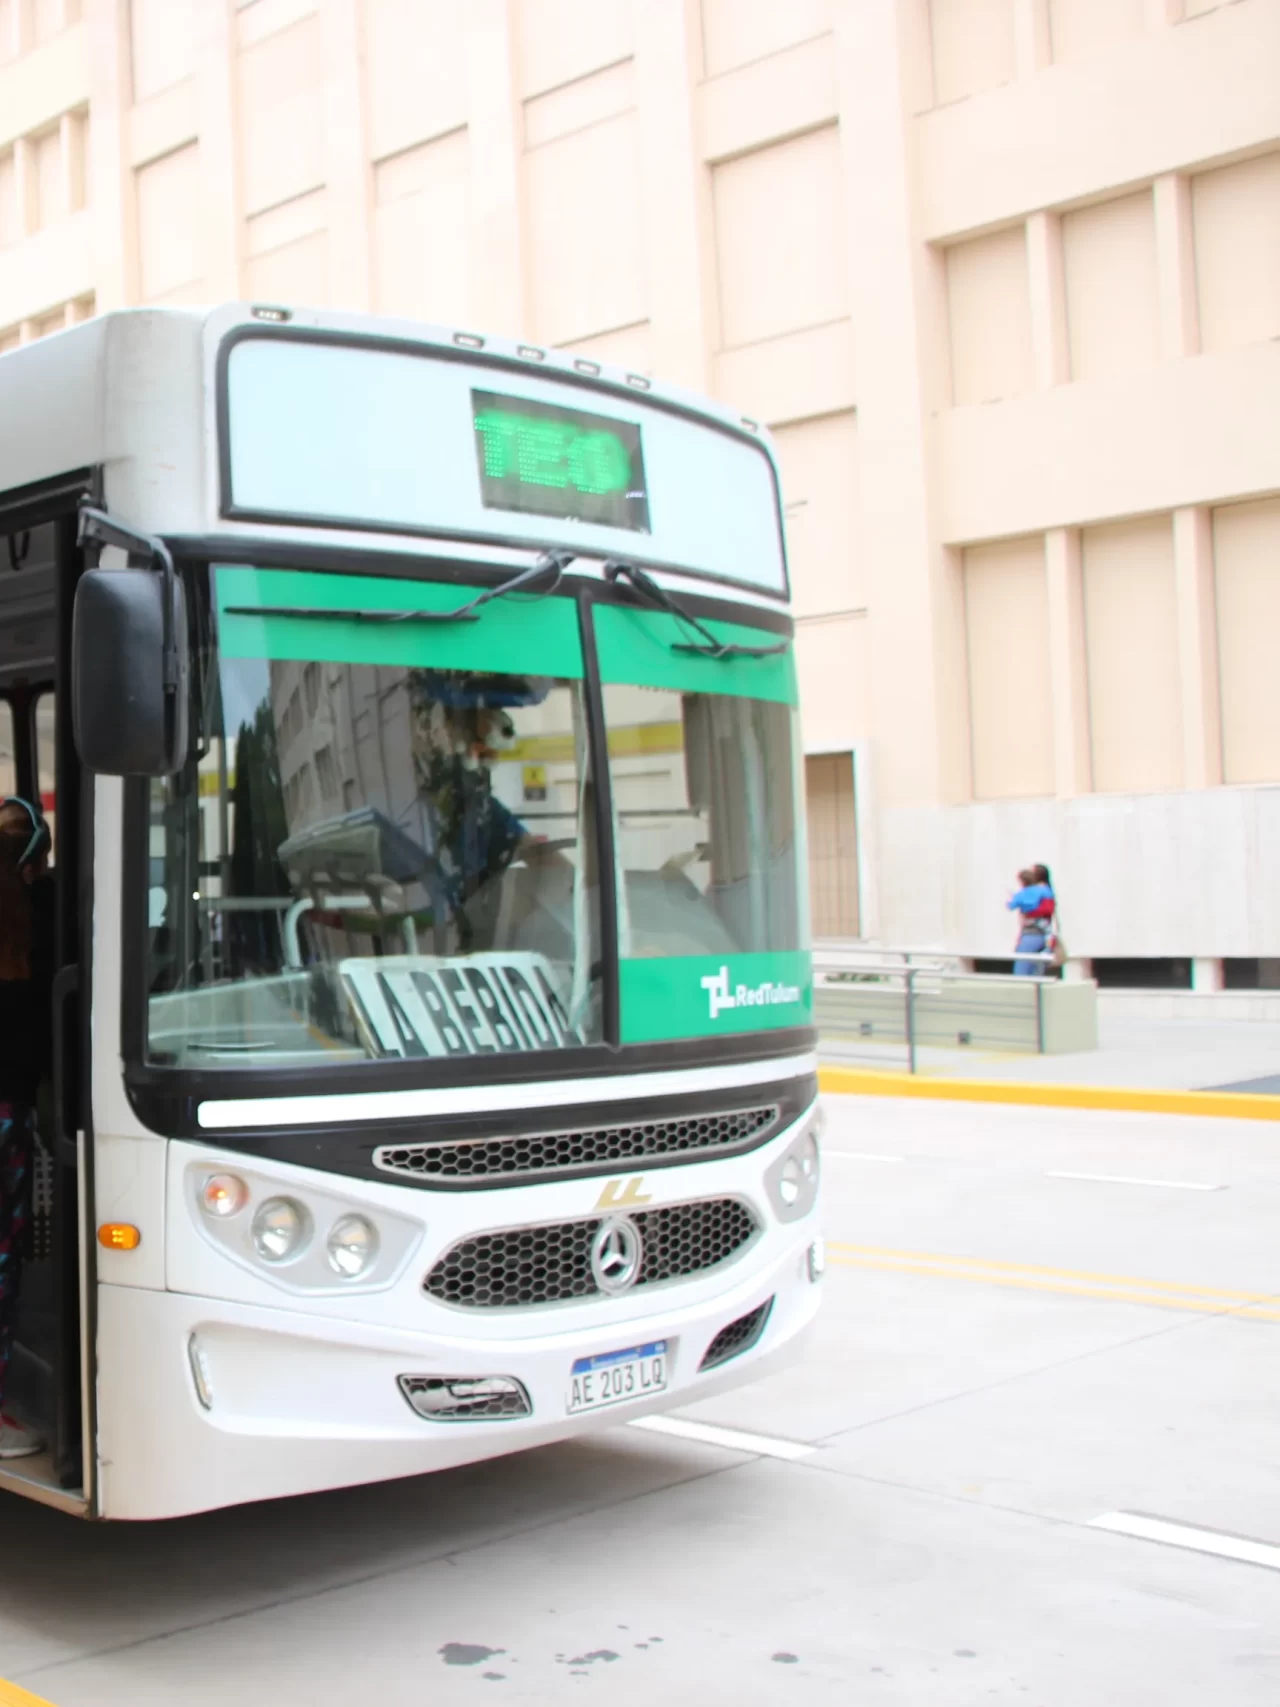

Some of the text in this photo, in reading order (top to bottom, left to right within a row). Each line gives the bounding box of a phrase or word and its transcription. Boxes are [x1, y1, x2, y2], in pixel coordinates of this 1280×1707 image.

[341, 965, 586, 1058] LA BEBIDA
[736, 982, 800, 1007] RedTulum
[571, 1358, 663, 1408] AE 203 LQ
